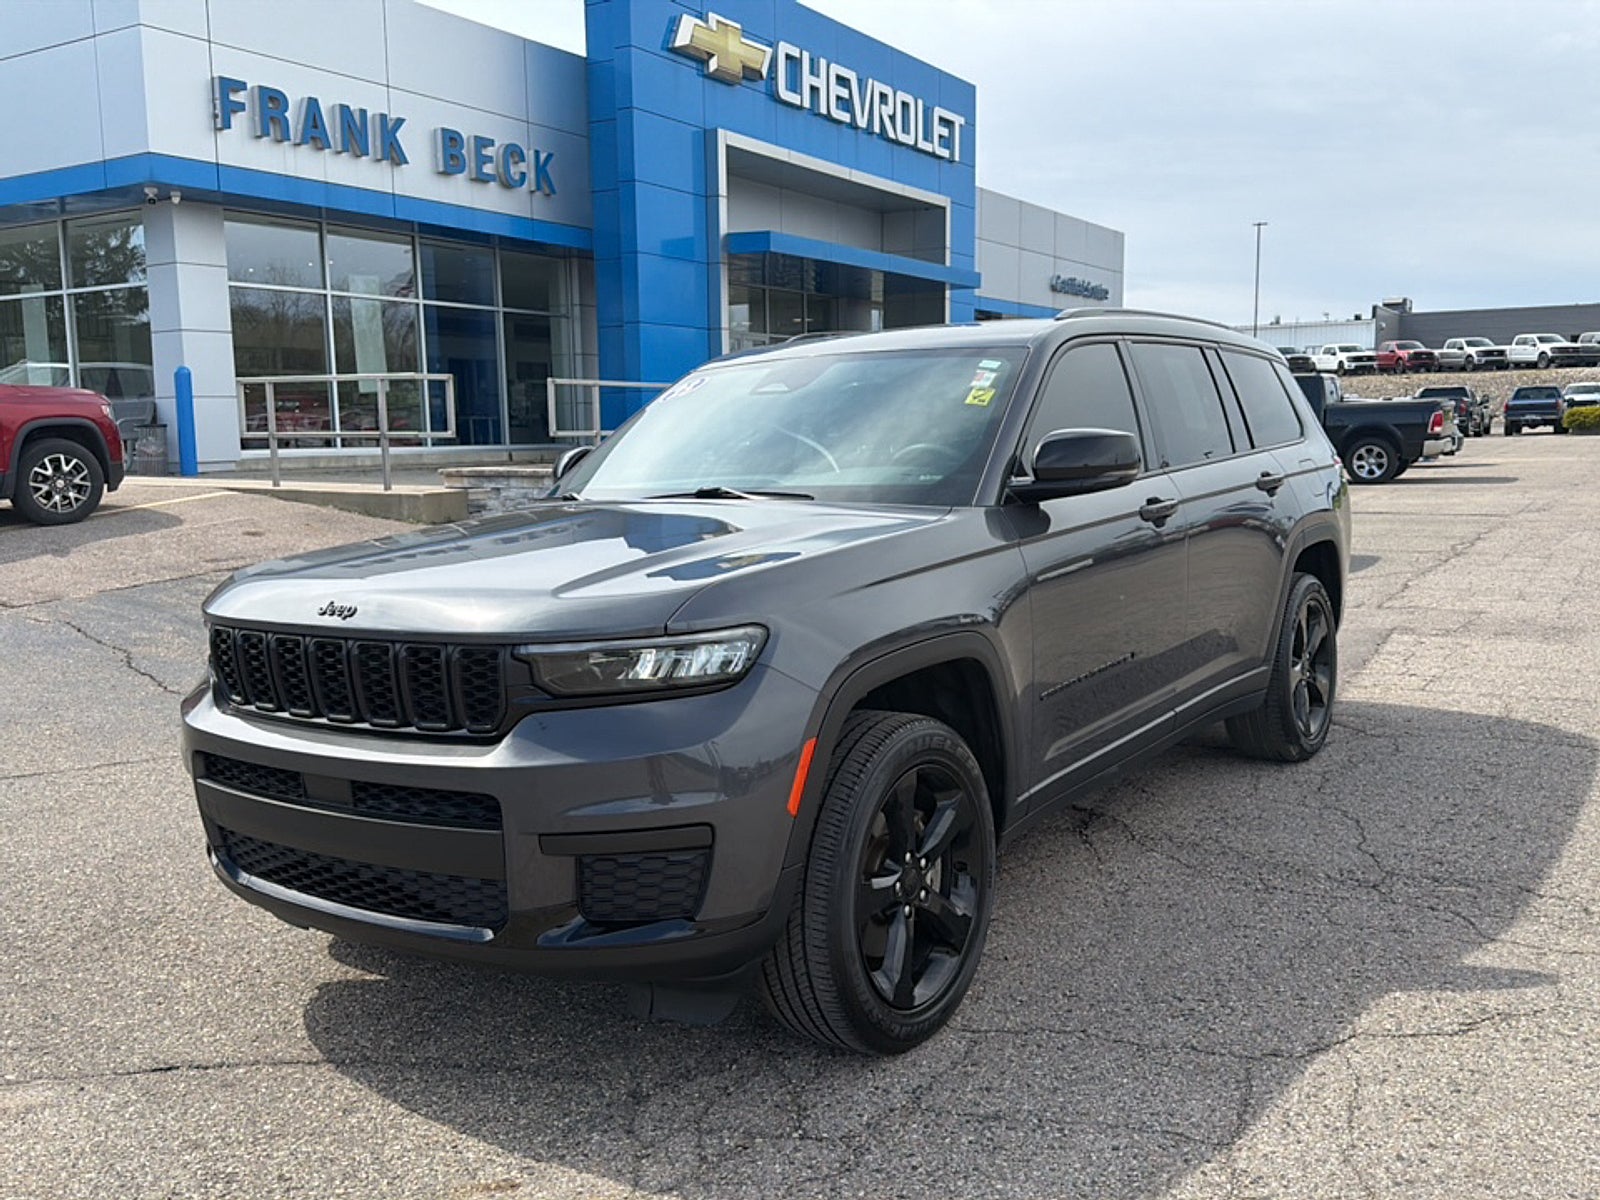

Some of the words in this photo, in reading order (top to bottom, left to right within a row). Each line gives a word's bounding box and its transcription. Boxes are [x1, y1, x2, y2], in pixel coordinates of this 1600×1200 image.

[213, 75, 409, 166] FRANK
[435, 126, 557, 196] BECK
[776, 40, 965, 162] CHEVROLET
[318, 601, 358, 621] Jeep
